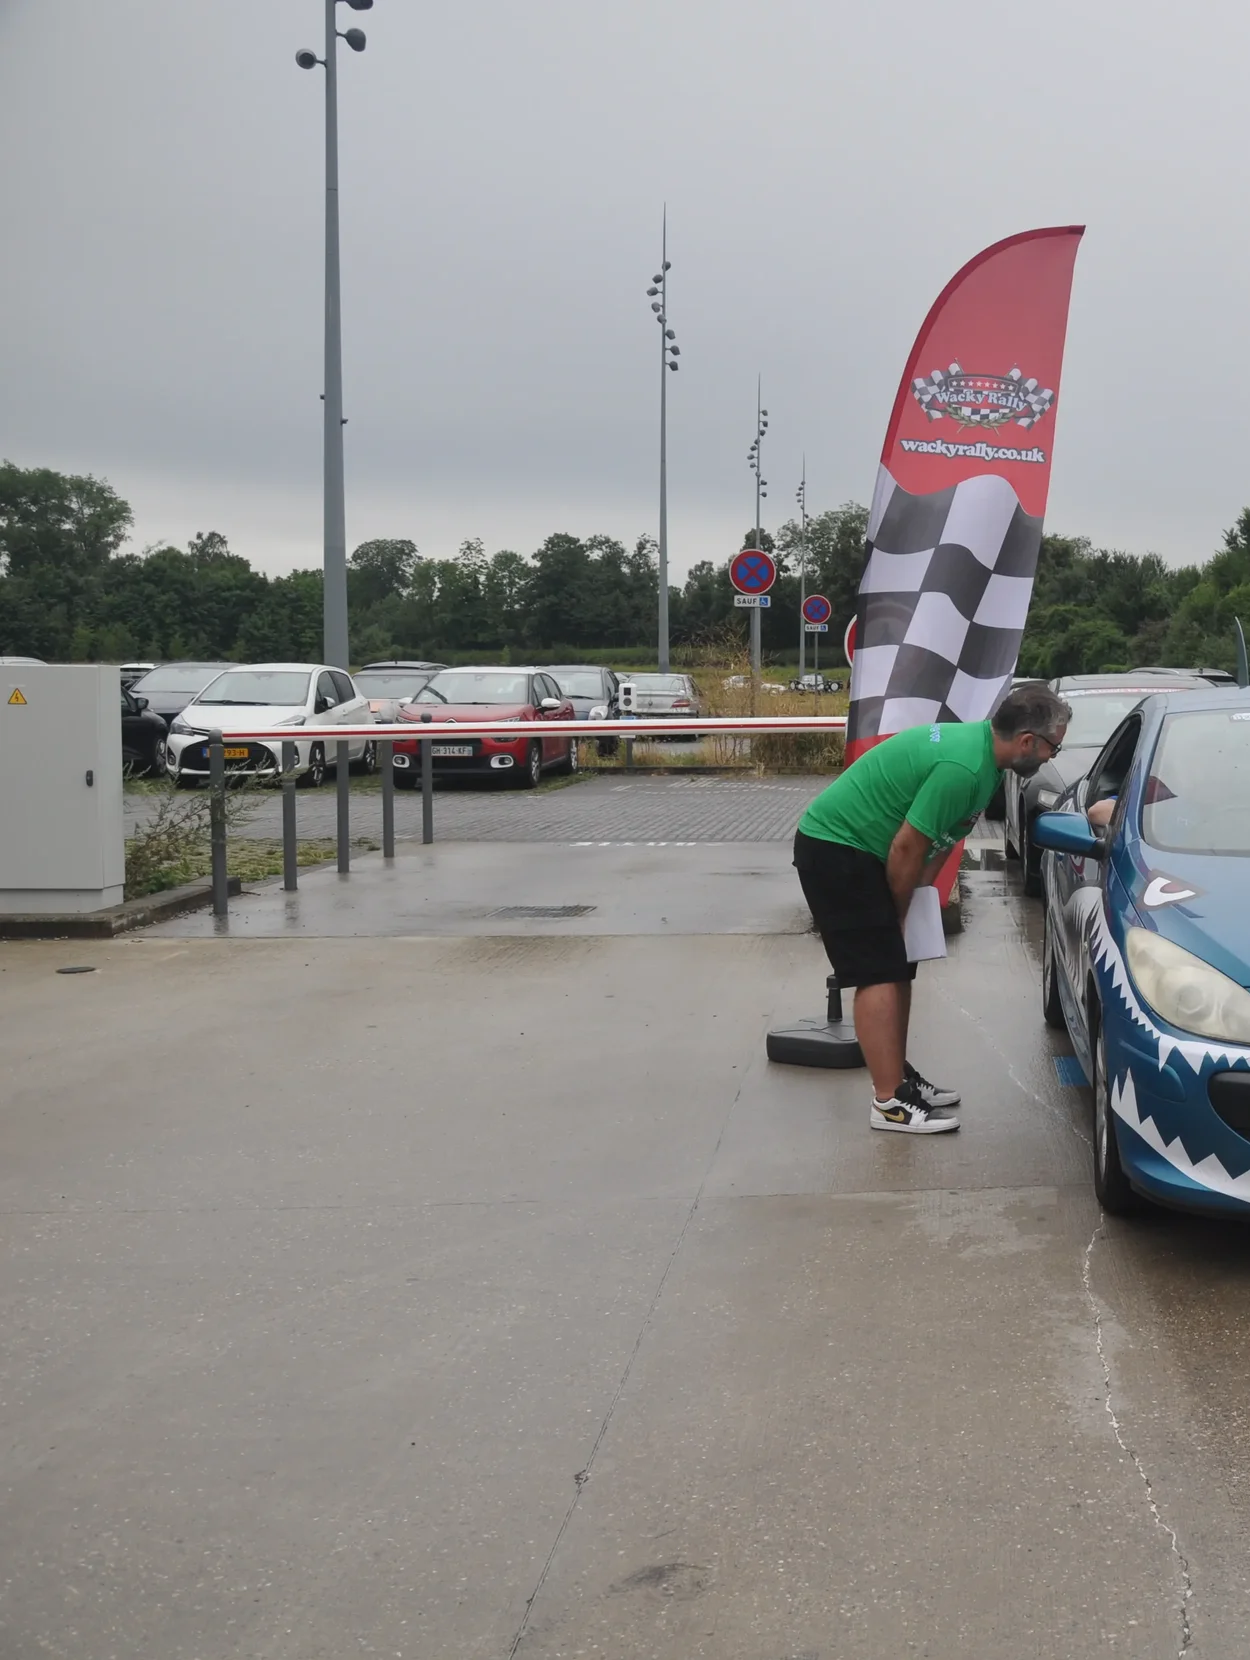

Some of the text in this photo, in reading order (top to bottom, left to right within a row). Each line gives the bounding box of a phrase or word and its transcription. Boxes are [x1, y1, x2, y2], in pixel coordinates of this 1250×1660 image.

[935, 387, 1027, 411] Wacky Rally
[900, 439, 1045, 463] wackyrally.co.uk
